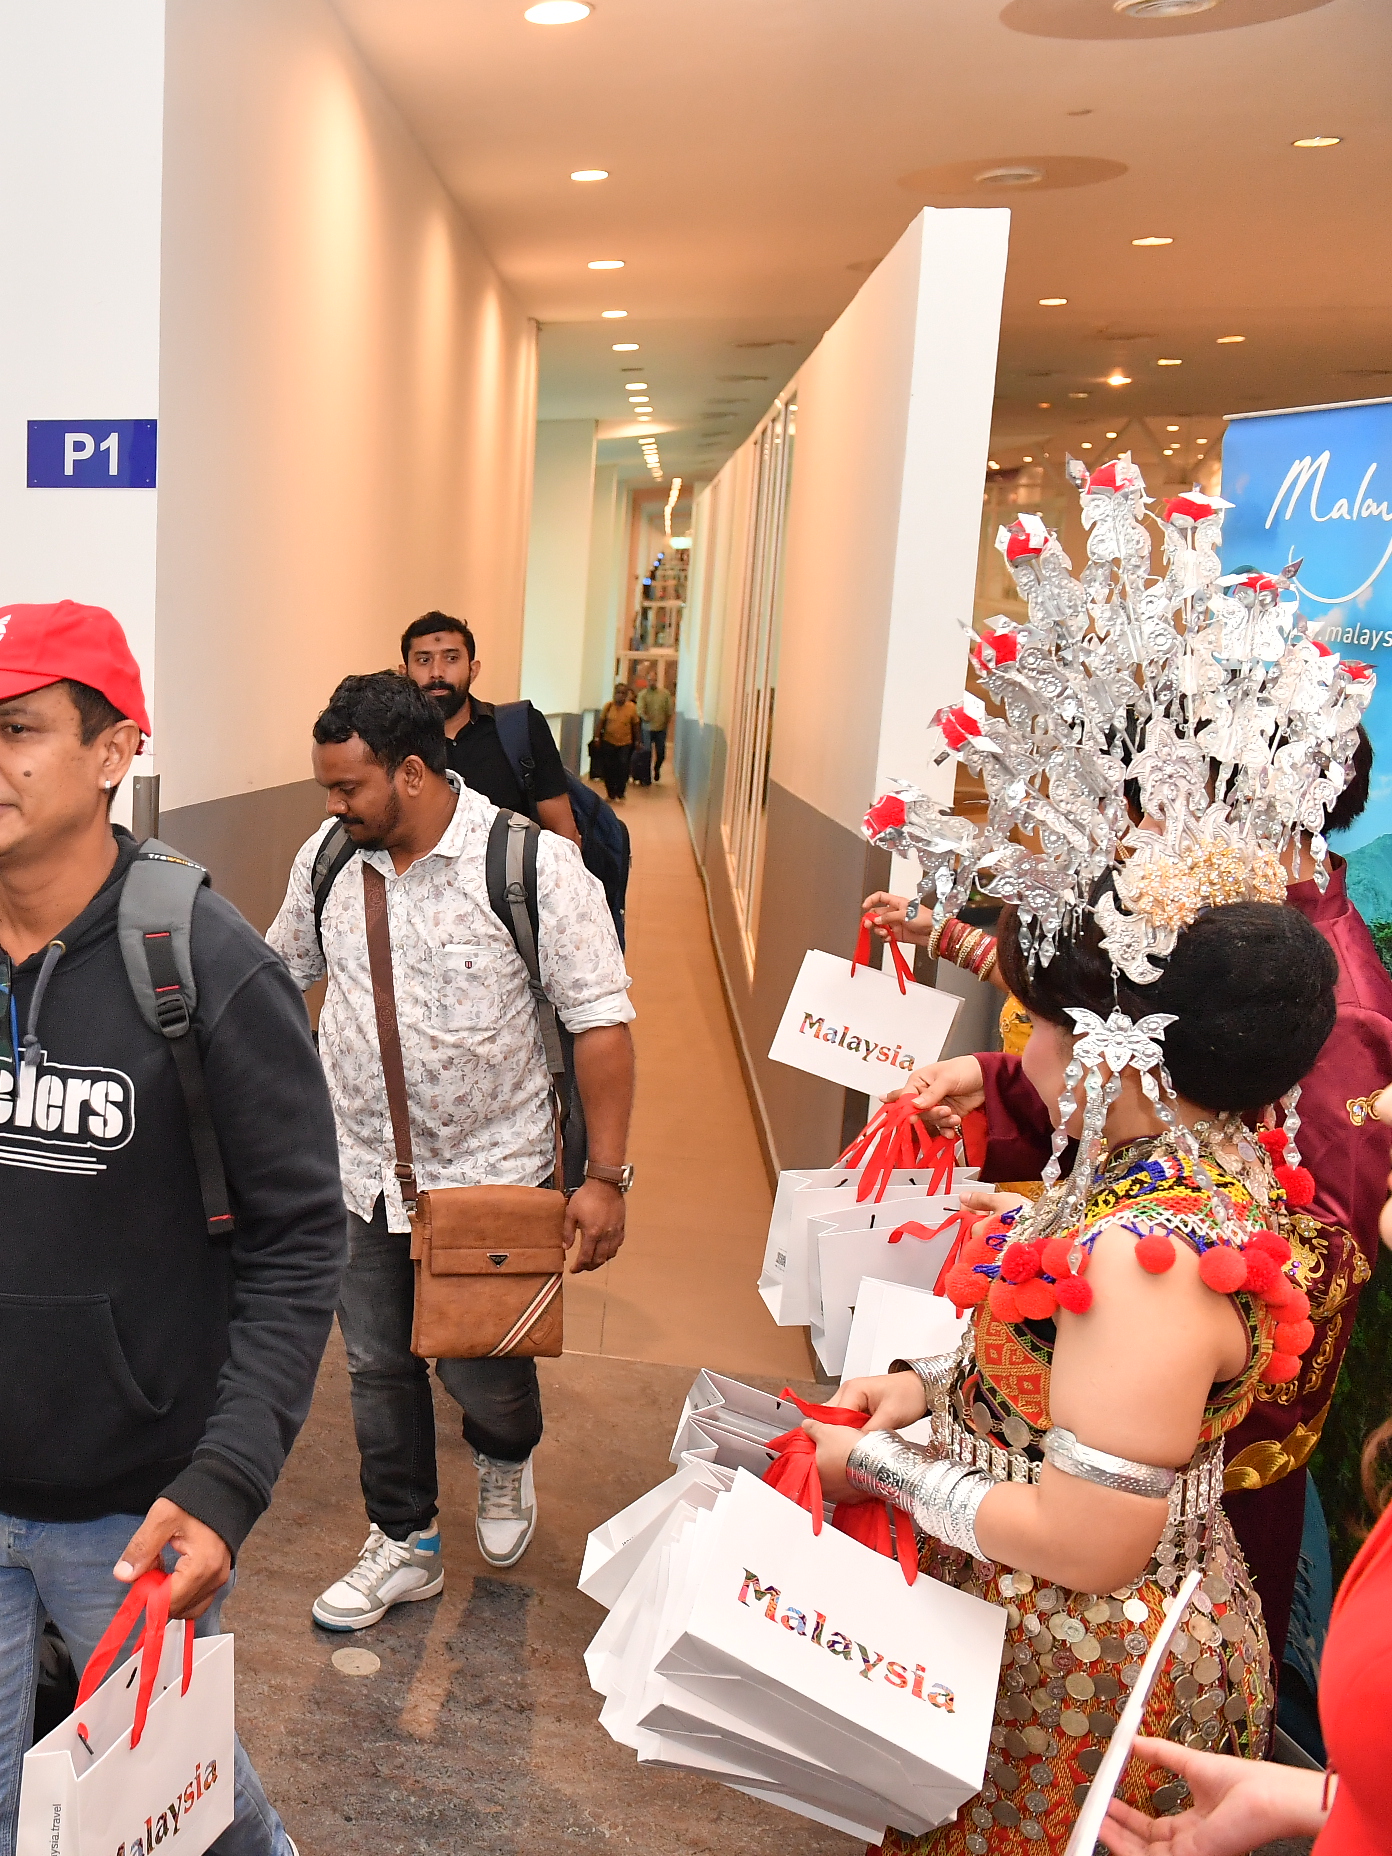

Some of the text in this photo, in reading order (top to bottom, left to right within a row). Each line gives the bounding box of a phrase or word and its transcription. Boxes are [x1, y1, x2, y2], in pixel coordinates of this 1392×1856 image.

[64, 432, 119, 476] P1
[799, 1011, 916, 1072] Malaysia
[738, 1567, 956, 1714] Malaysia
